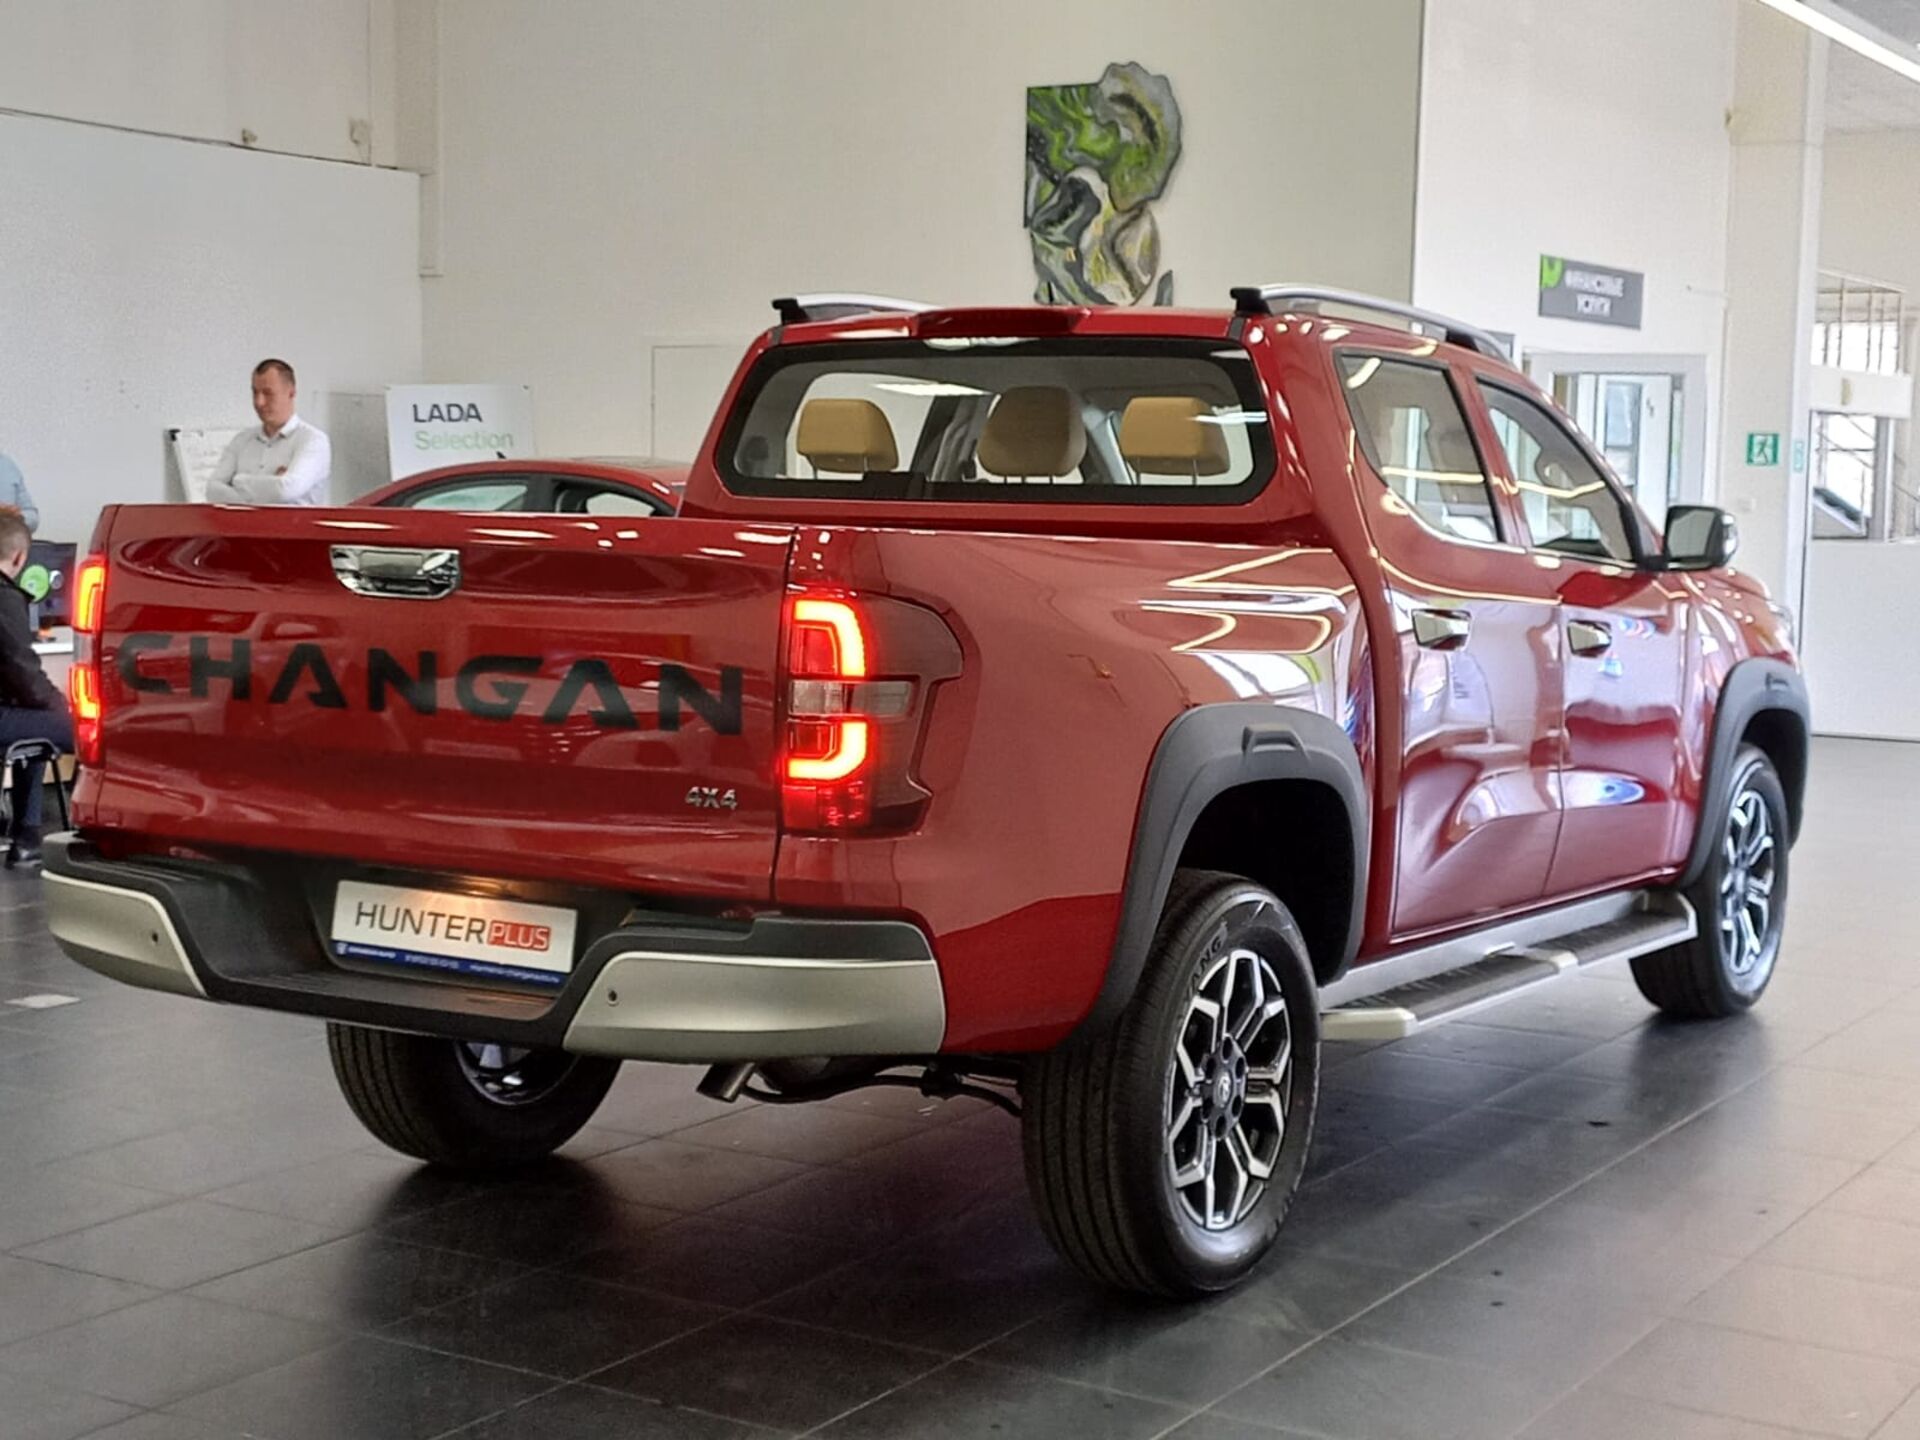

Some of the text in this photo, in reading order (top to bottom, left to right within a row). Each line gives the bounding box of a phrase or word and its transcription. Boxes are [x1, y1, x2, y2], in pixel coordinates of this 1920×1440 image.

[412, 403, 483, 423] LADA
[415, 430, 514, 450] Selection
[117, 632, 743, 736] CHANGAN
